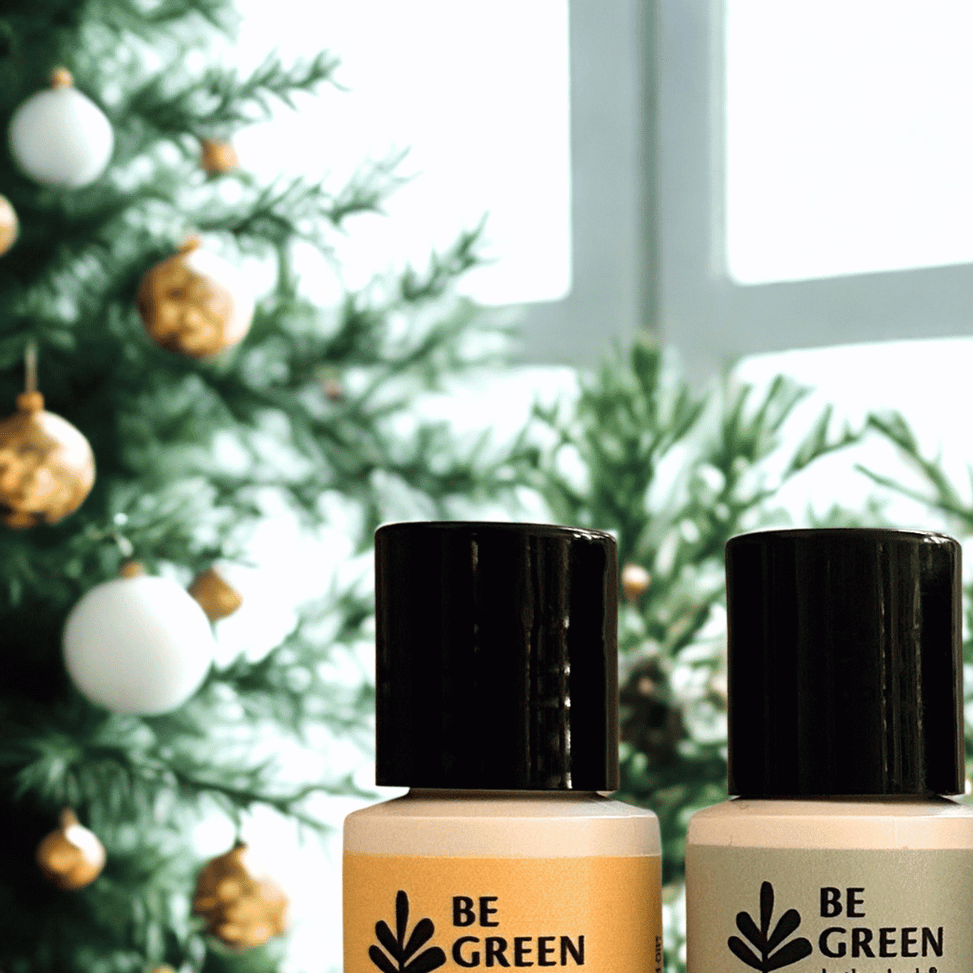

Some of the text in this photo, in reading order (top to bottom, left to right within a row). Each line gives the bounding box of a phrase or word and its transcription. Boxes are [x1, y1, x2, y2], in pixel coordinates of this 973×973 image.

[452, 895, 500, 928] BE
[819, 886, 866, 919] BE
[451, 934, 585, 969] GREEN
[818, 926, 944, 959] GREEN
